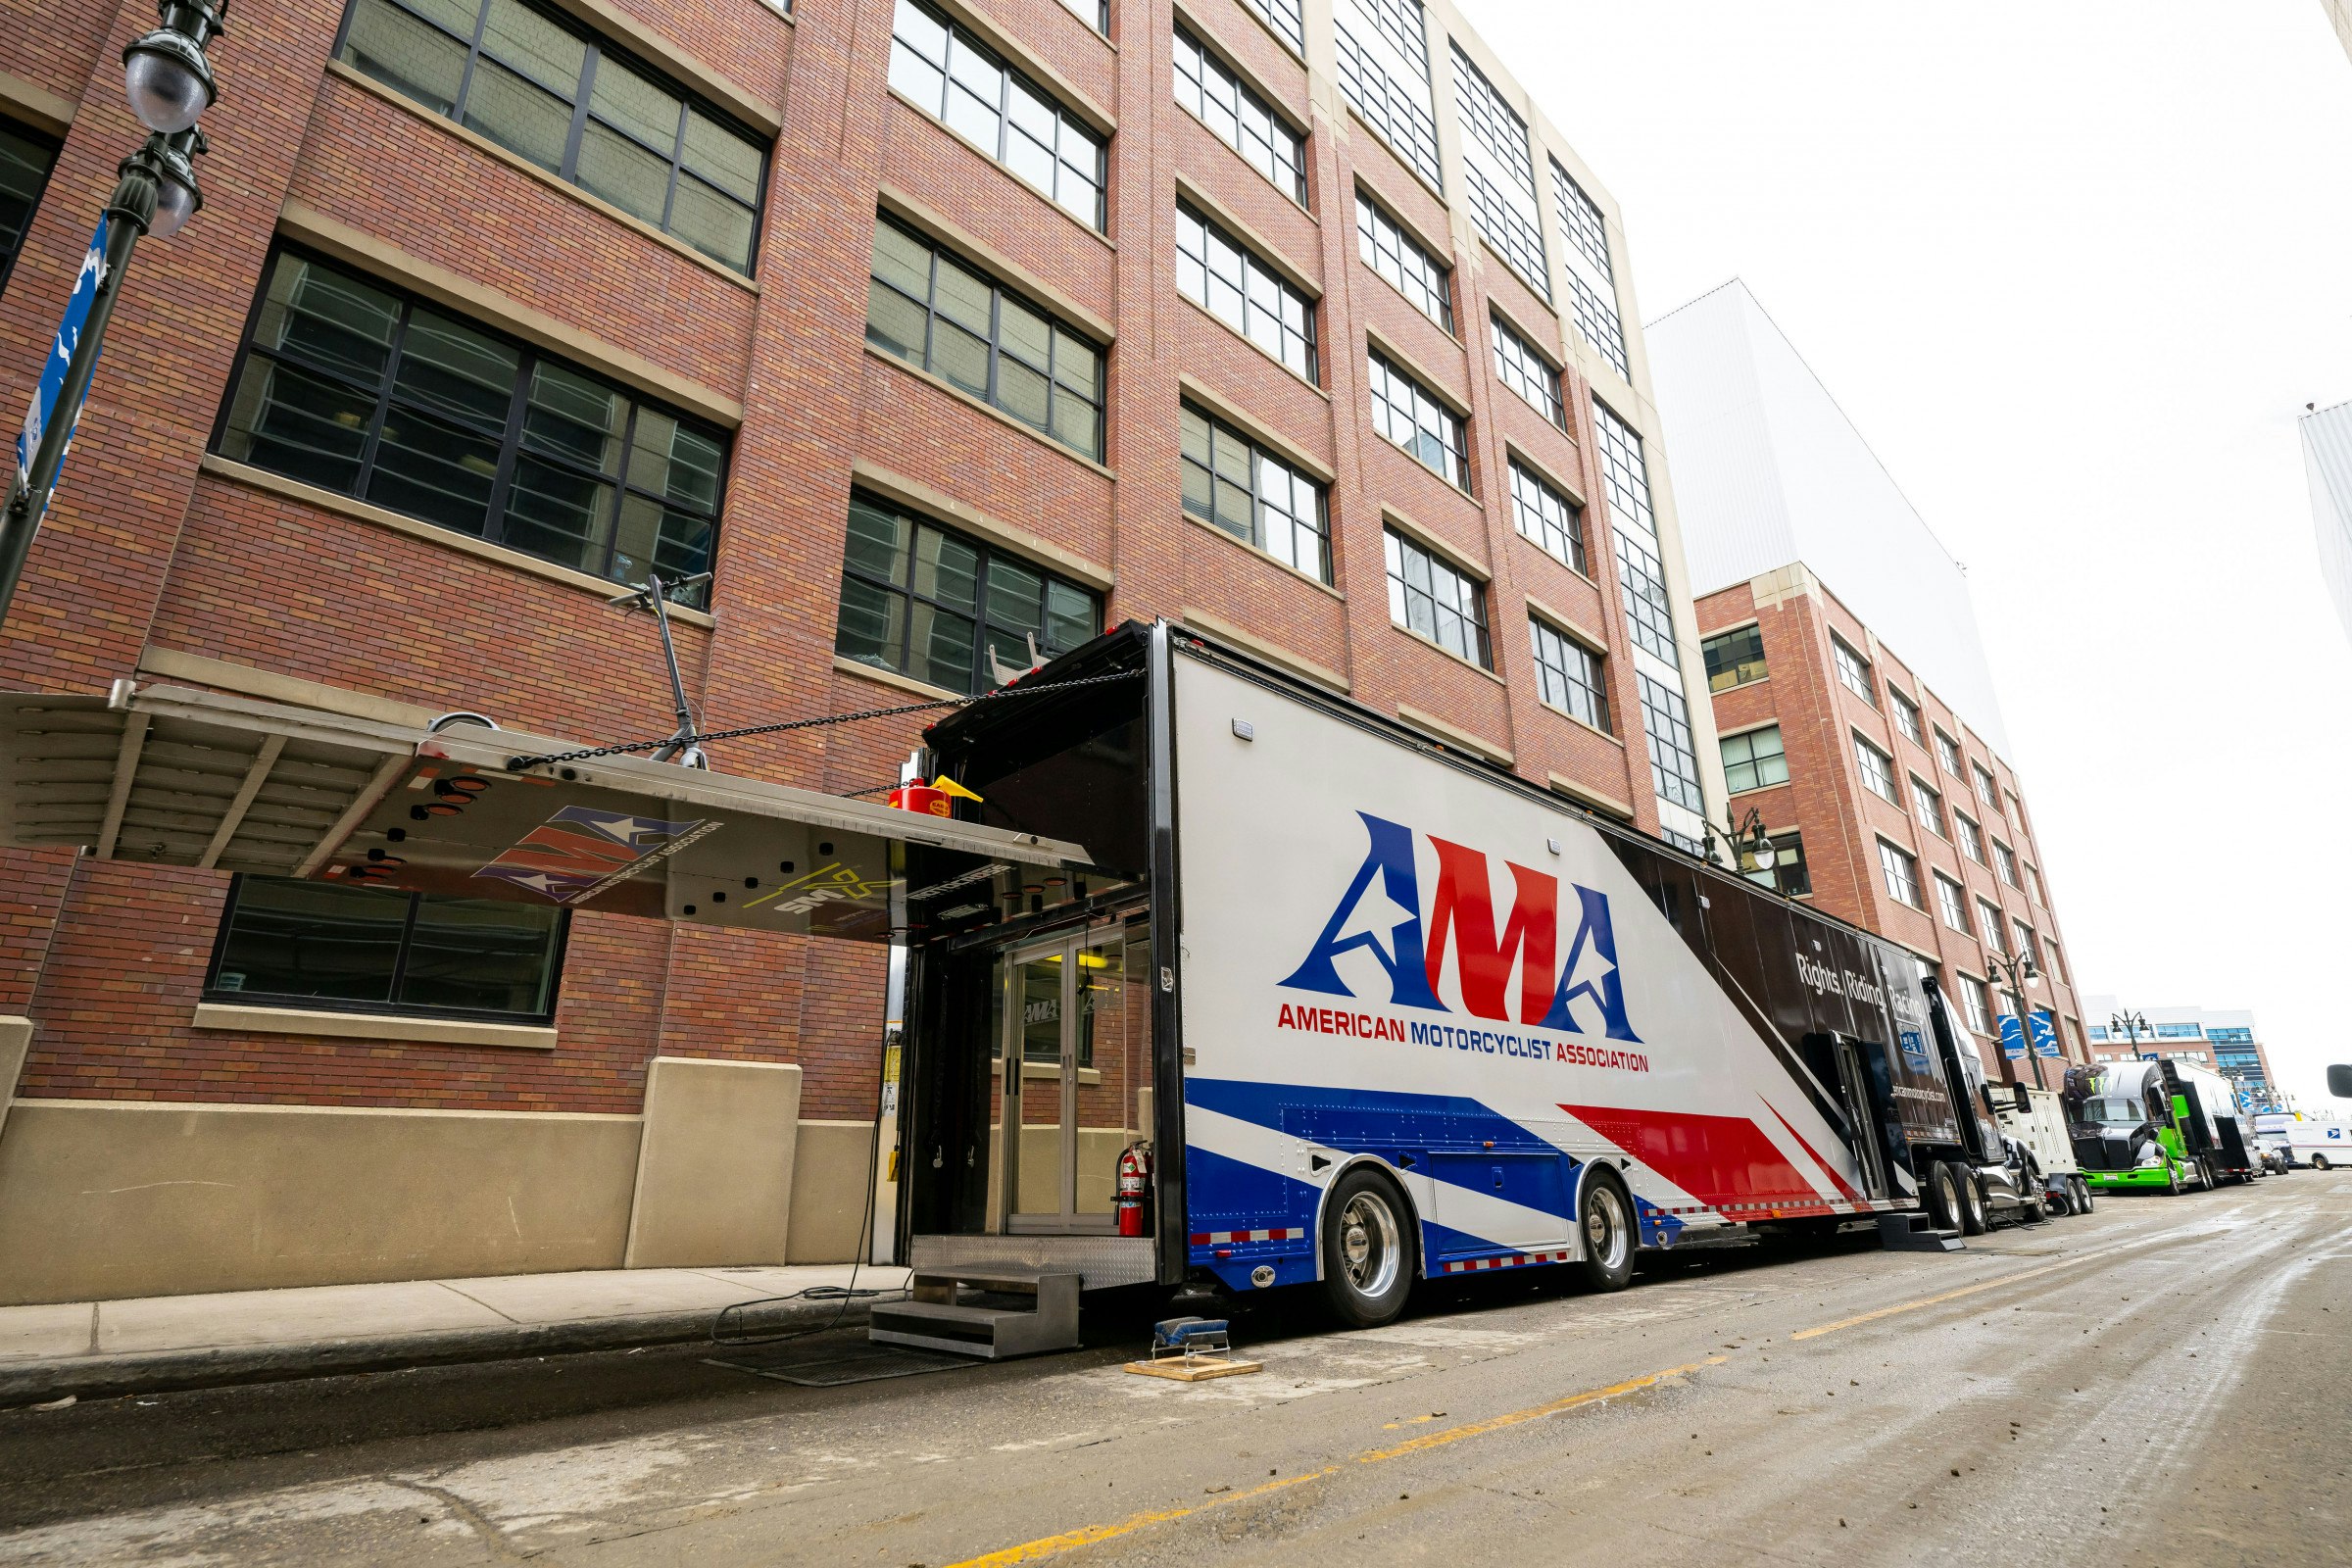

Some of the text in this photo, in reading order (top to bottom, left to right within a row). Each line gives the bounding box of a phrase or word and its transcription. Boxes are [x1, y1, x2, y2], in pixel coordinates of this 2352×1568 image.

[470, 805, 707, 903] AMA
[658, 821, 725, 857] ASSOCIATION
[1276, 810, 1644, 1044] AMA
[1795, 953, 1844, 996] Rights.
[1022, 999, 1059, 1022] AMA
[1278, 1003, 1649, 1073] AMERICAN MOTORCYCLIST ASSOCIATION
